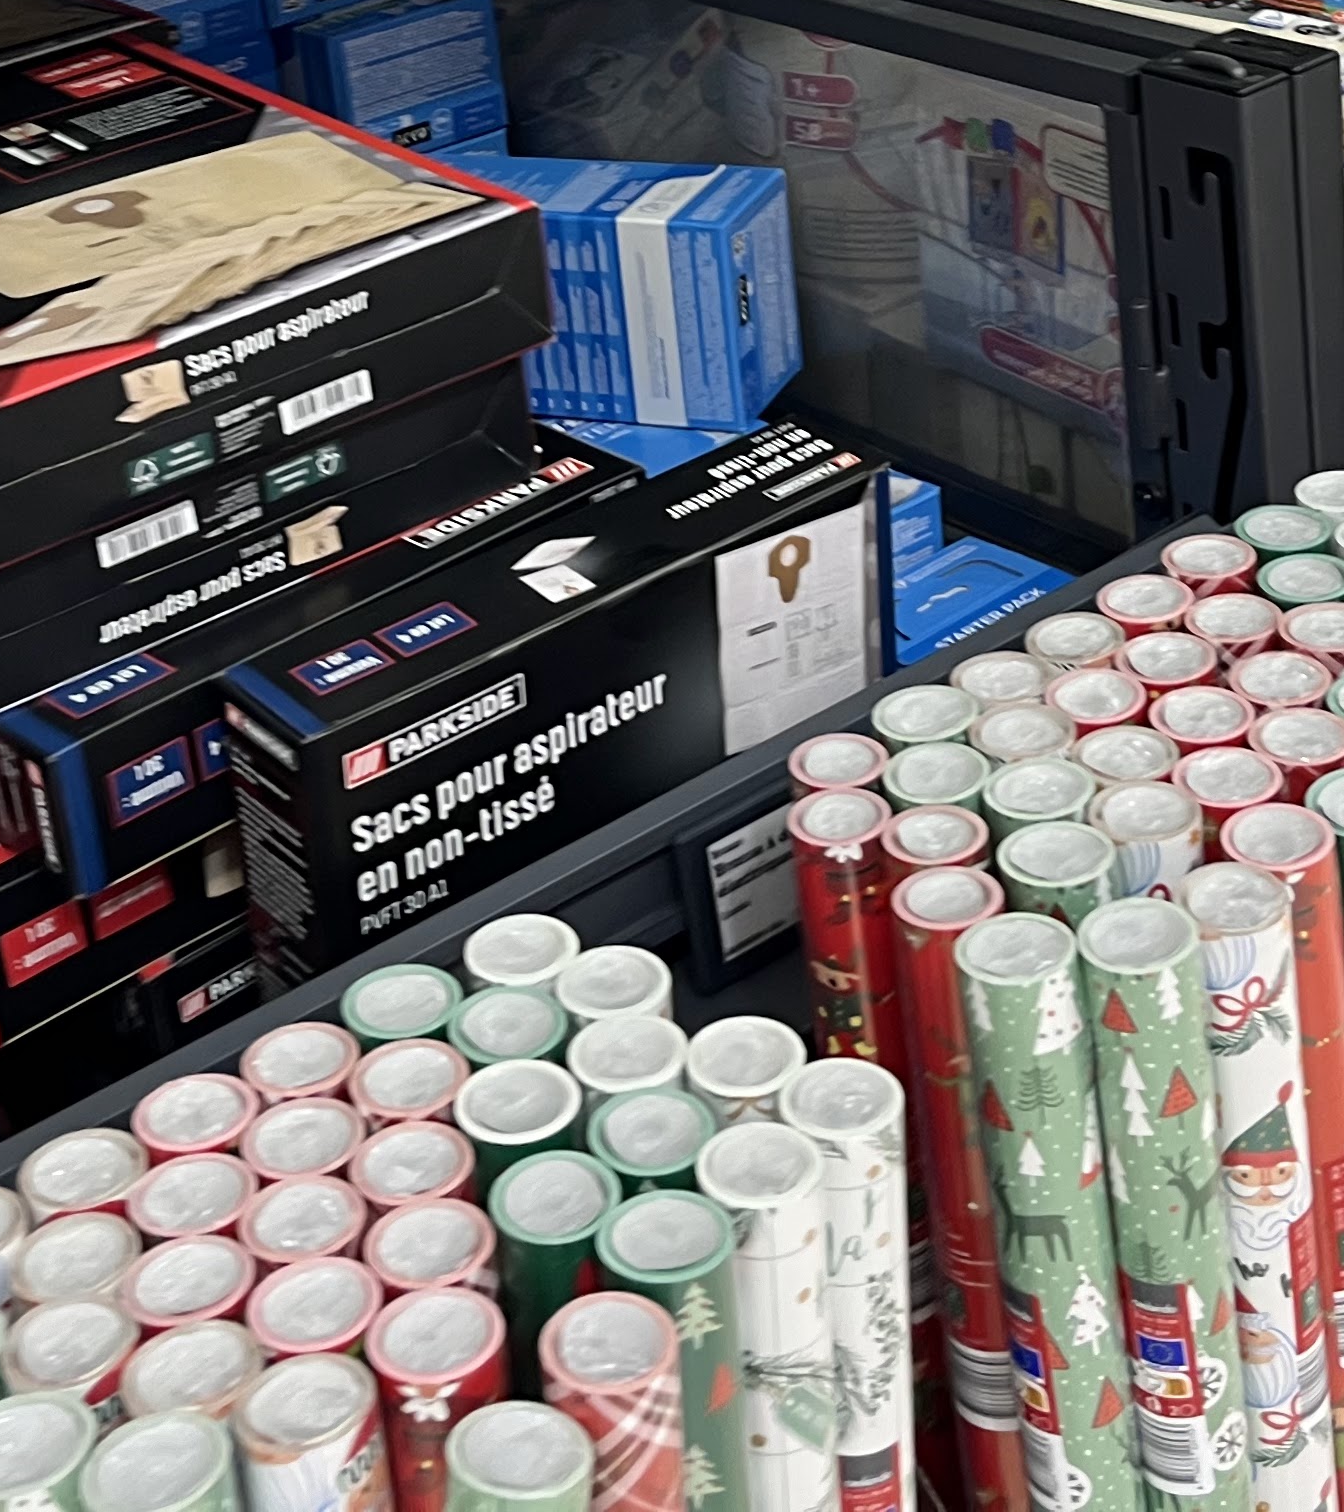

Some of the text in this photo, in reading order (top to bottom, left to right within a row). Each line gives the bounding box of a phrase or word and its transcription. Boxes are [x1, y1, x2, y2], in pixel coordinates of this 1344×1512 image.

[184, 289, 372, 378] Sacs pour aspirateur
[664, 437, 834, 521] Sacs pour aspirateur
[706, 428, 812, 480] en non-tissé
[418, 471, 546, 548] PARKSIDE
[98, 548, 289, 646] Sacs pour aspirateur
[933, 583, 1050, 652] STARTER PACK
[348, 671, 670, 856] Sacs pour aspirateur
[384, 679, 518, 766] PARKSIDE
[356, 774, 559, 906] en non-tissé
